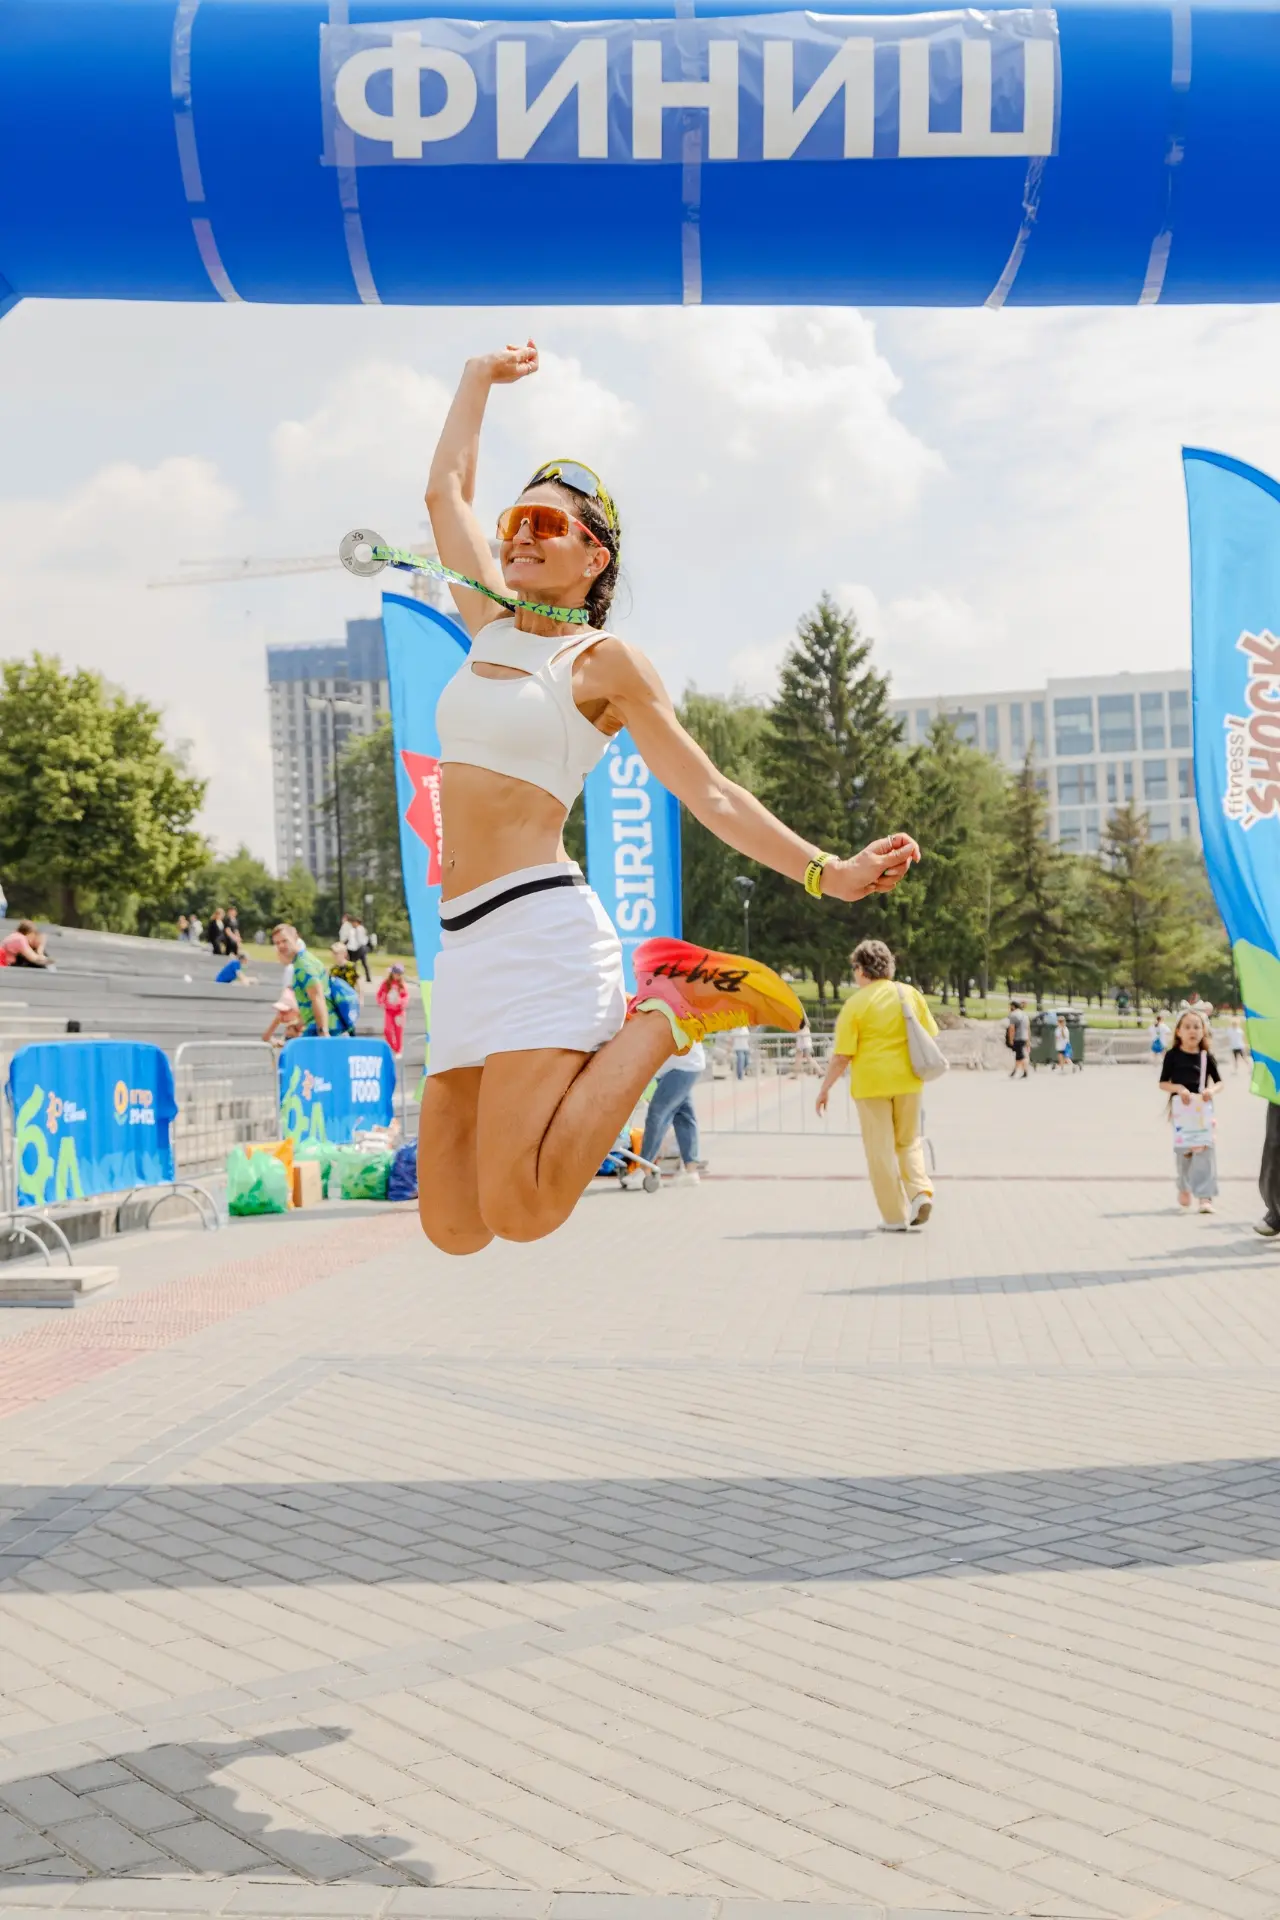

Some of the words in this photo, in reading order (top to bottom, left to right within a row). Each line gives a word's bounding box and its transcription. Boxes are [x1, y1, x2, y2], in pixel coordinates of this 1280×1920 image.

[335, 31, 1055, 159] ФИНИШ
[1227, 734, 1244, 814] fitness
[1241, 635, 1280, 814] SHOCK
[608, 755, 656, 931] SIRIUS
